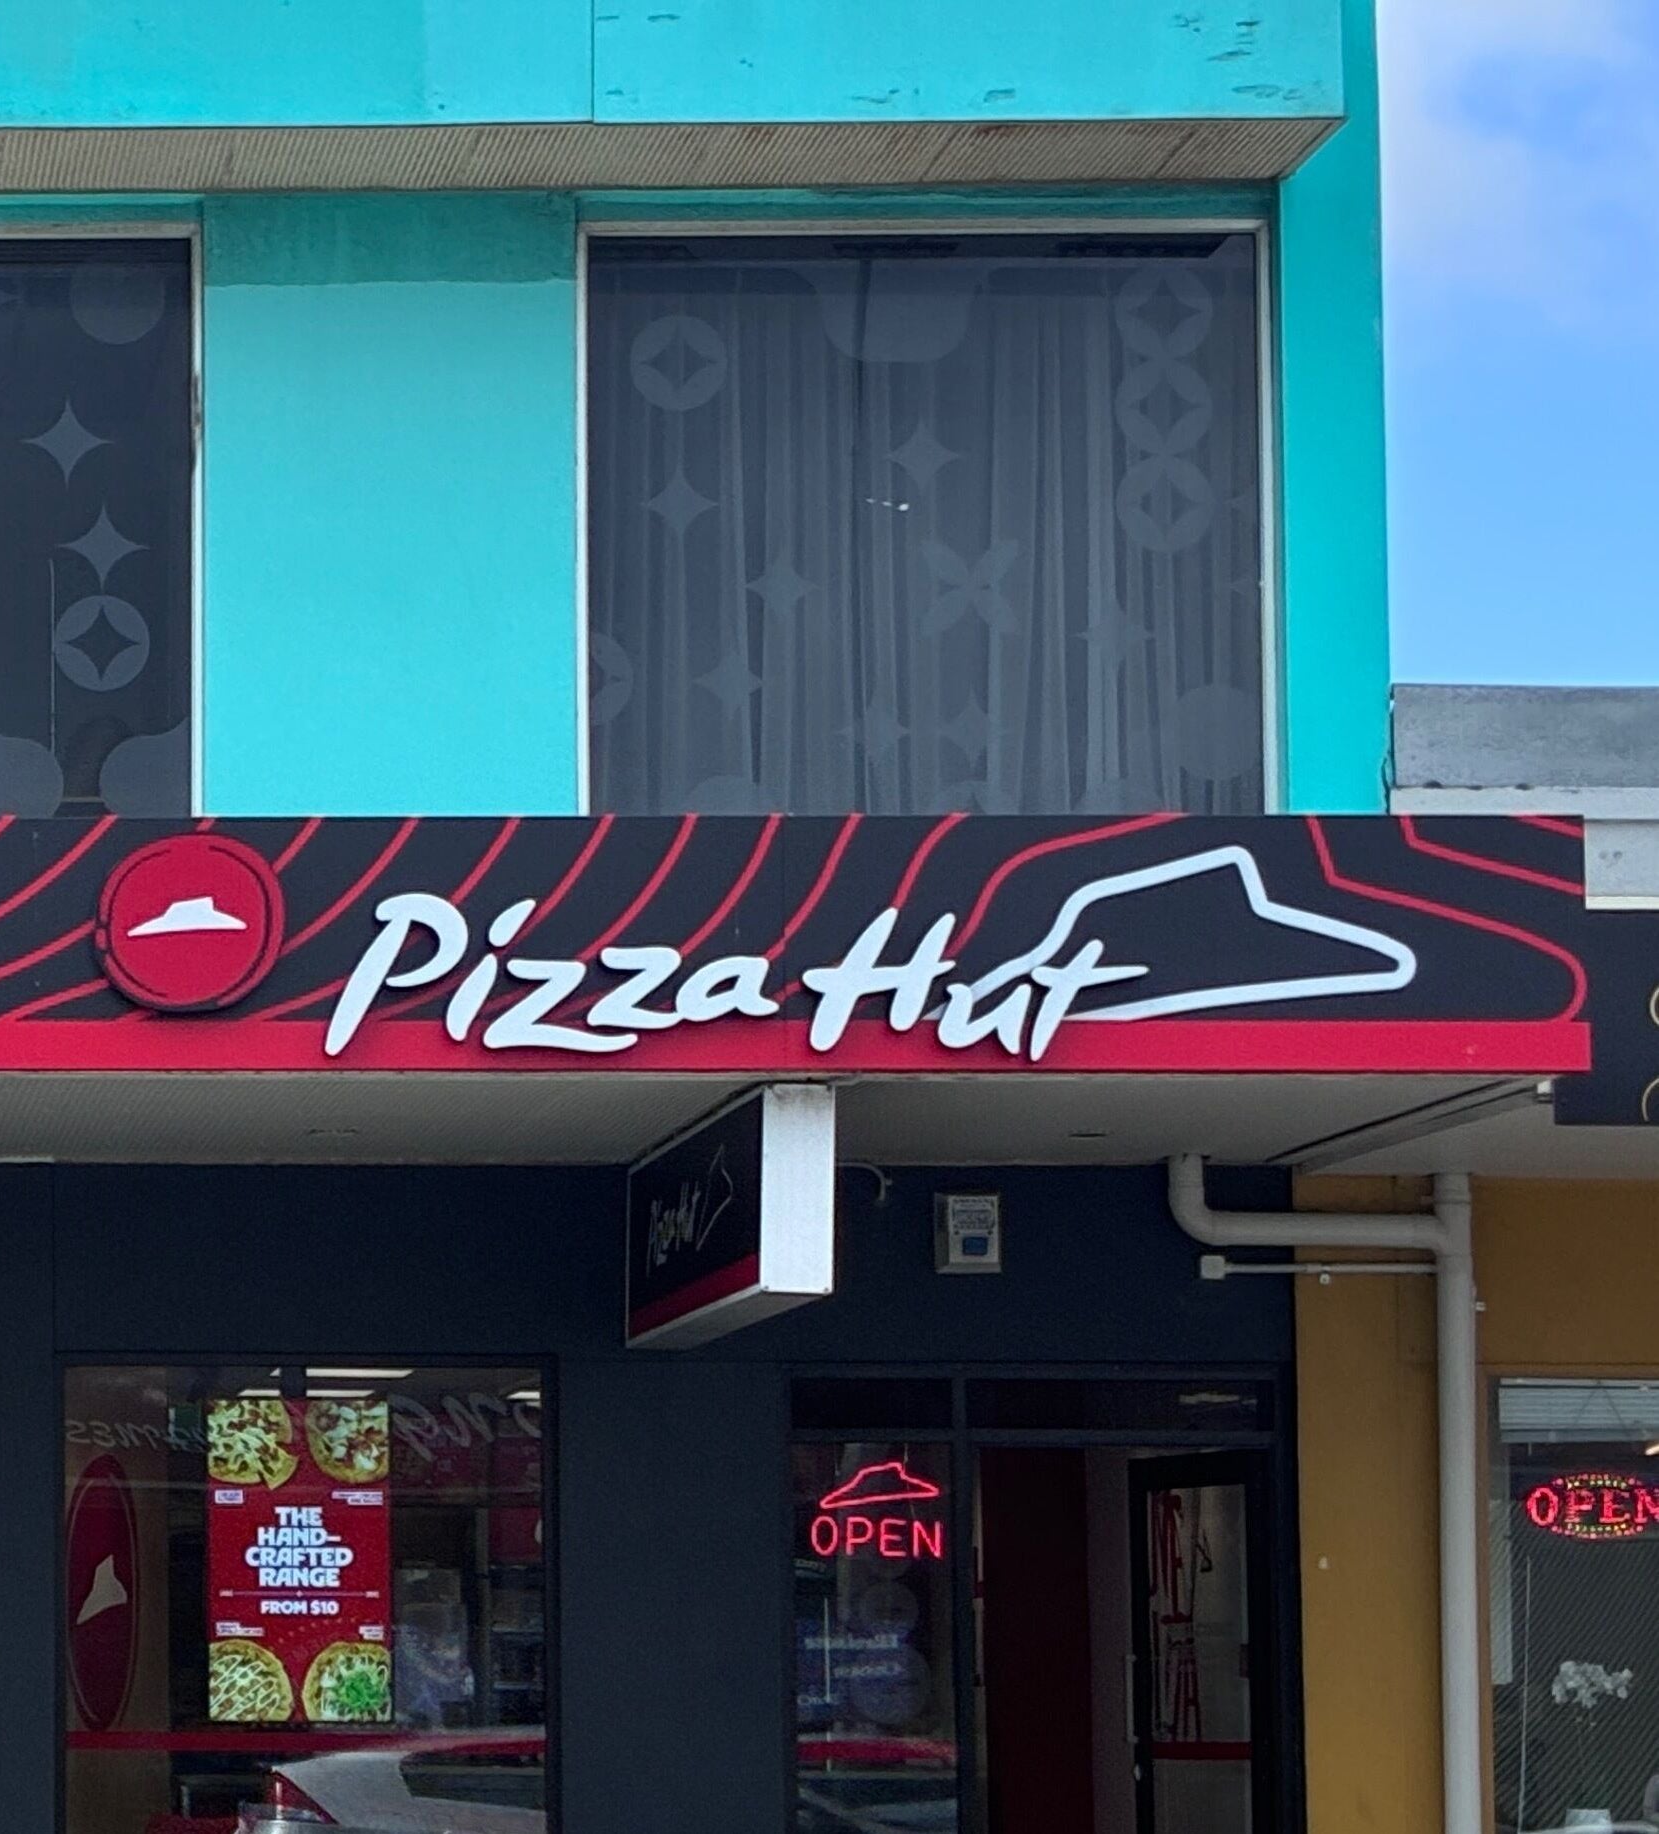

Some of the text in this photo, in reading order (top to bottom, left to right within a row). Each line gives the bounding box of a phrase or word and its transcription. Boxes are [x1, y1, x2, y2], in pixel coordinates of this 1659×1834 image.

[324, 892, 1149, 1062] Pizza Hut
[274, 1506, 323, 1527] THE
[810, 1514, 944, 1560] OPEN
[244, 1546, 354, 1568] CRAFTED
[259, 1567, 341, 1588] RANGE
[260, 1599, 340, 1616] FROM $10
